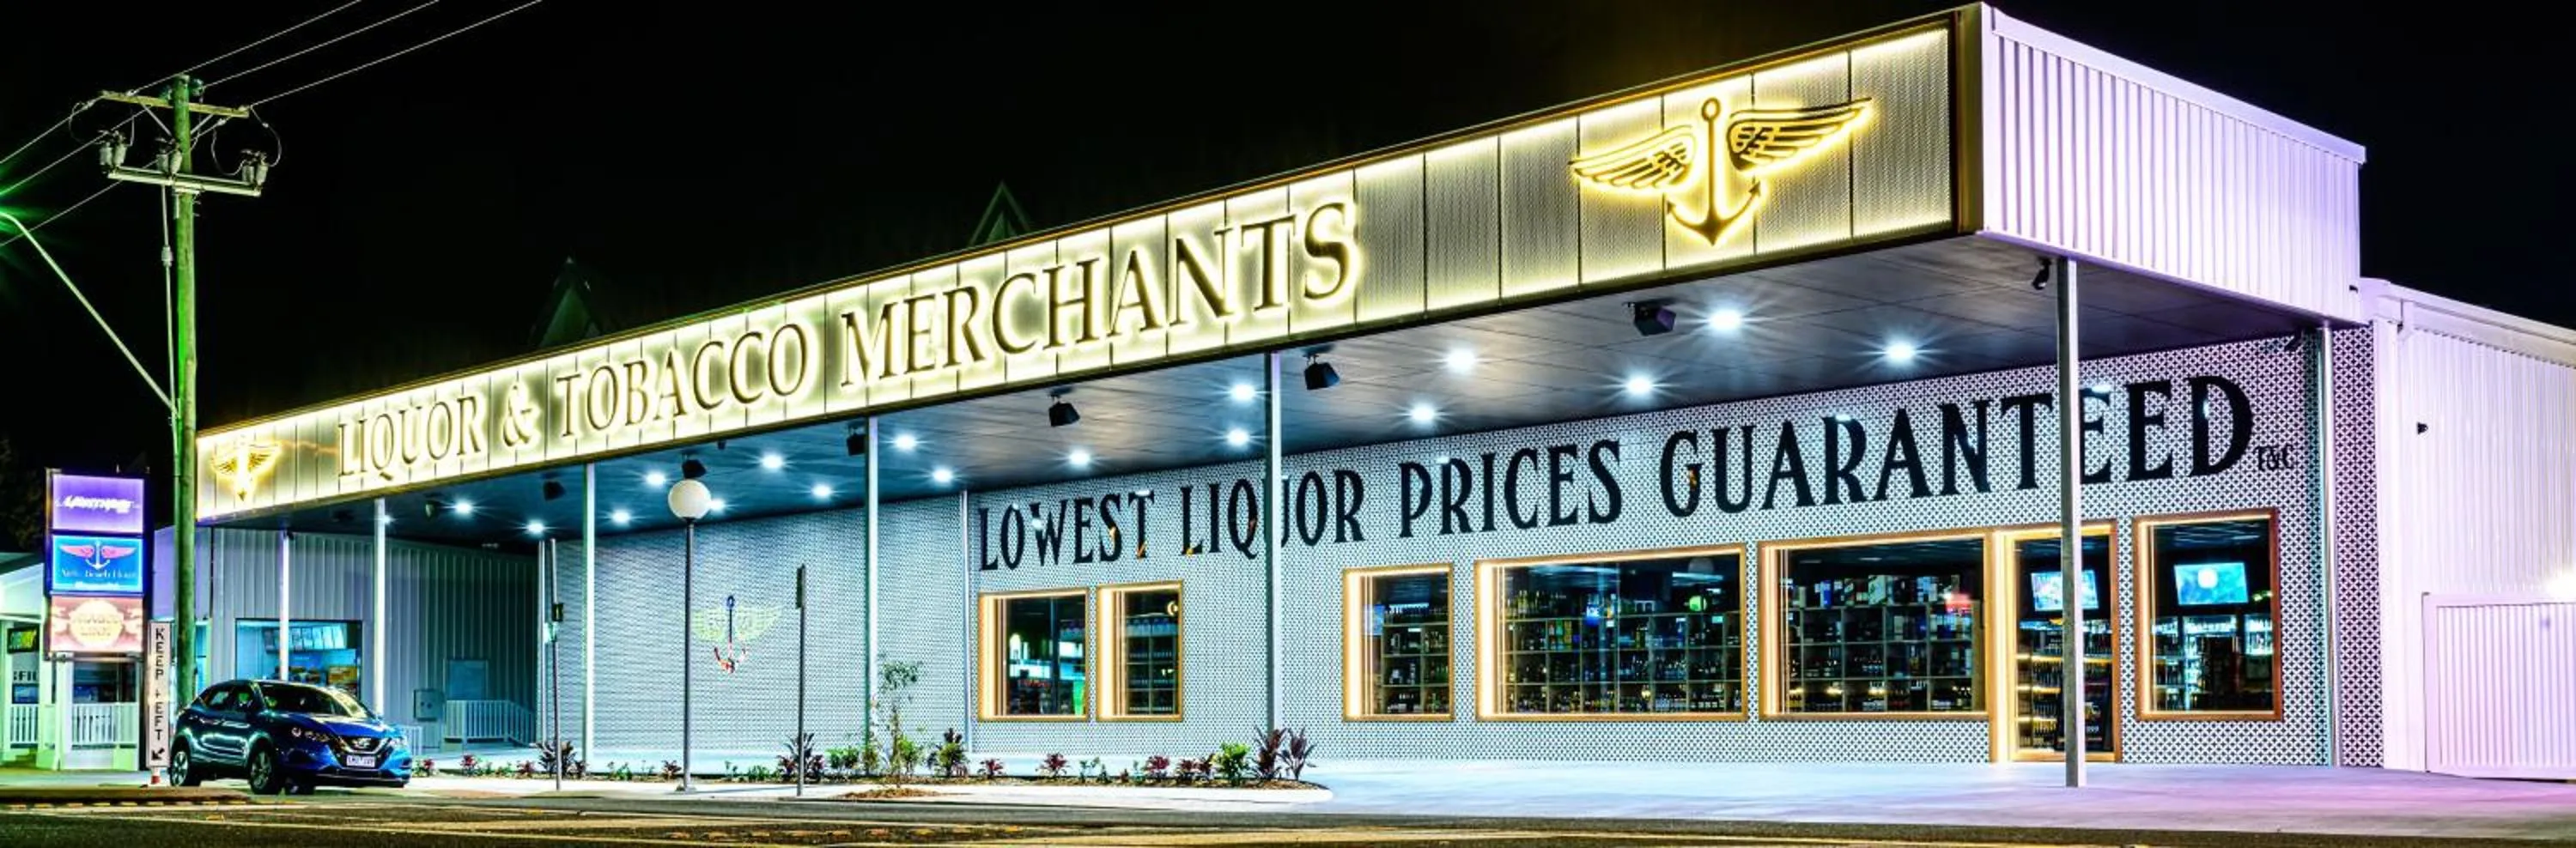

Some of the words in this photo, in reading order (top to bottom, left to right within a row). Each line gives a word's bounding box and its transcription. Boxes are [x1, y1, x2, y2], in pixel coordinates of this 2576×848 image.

[337, 396, 481, 481] LIQUOR
[502, 385, 533, 447] &
[556, 324, 808, 437] TOBACCO
[841, 203, 1354, 387] MERCHANTS
[979, 490, 1155, 571] LOWEST
[1398, 439, 1622, 538] PRICES
[1660, 376, 2253, 518] GUARANTEED
[155, 627, 165, 680] KEEP
